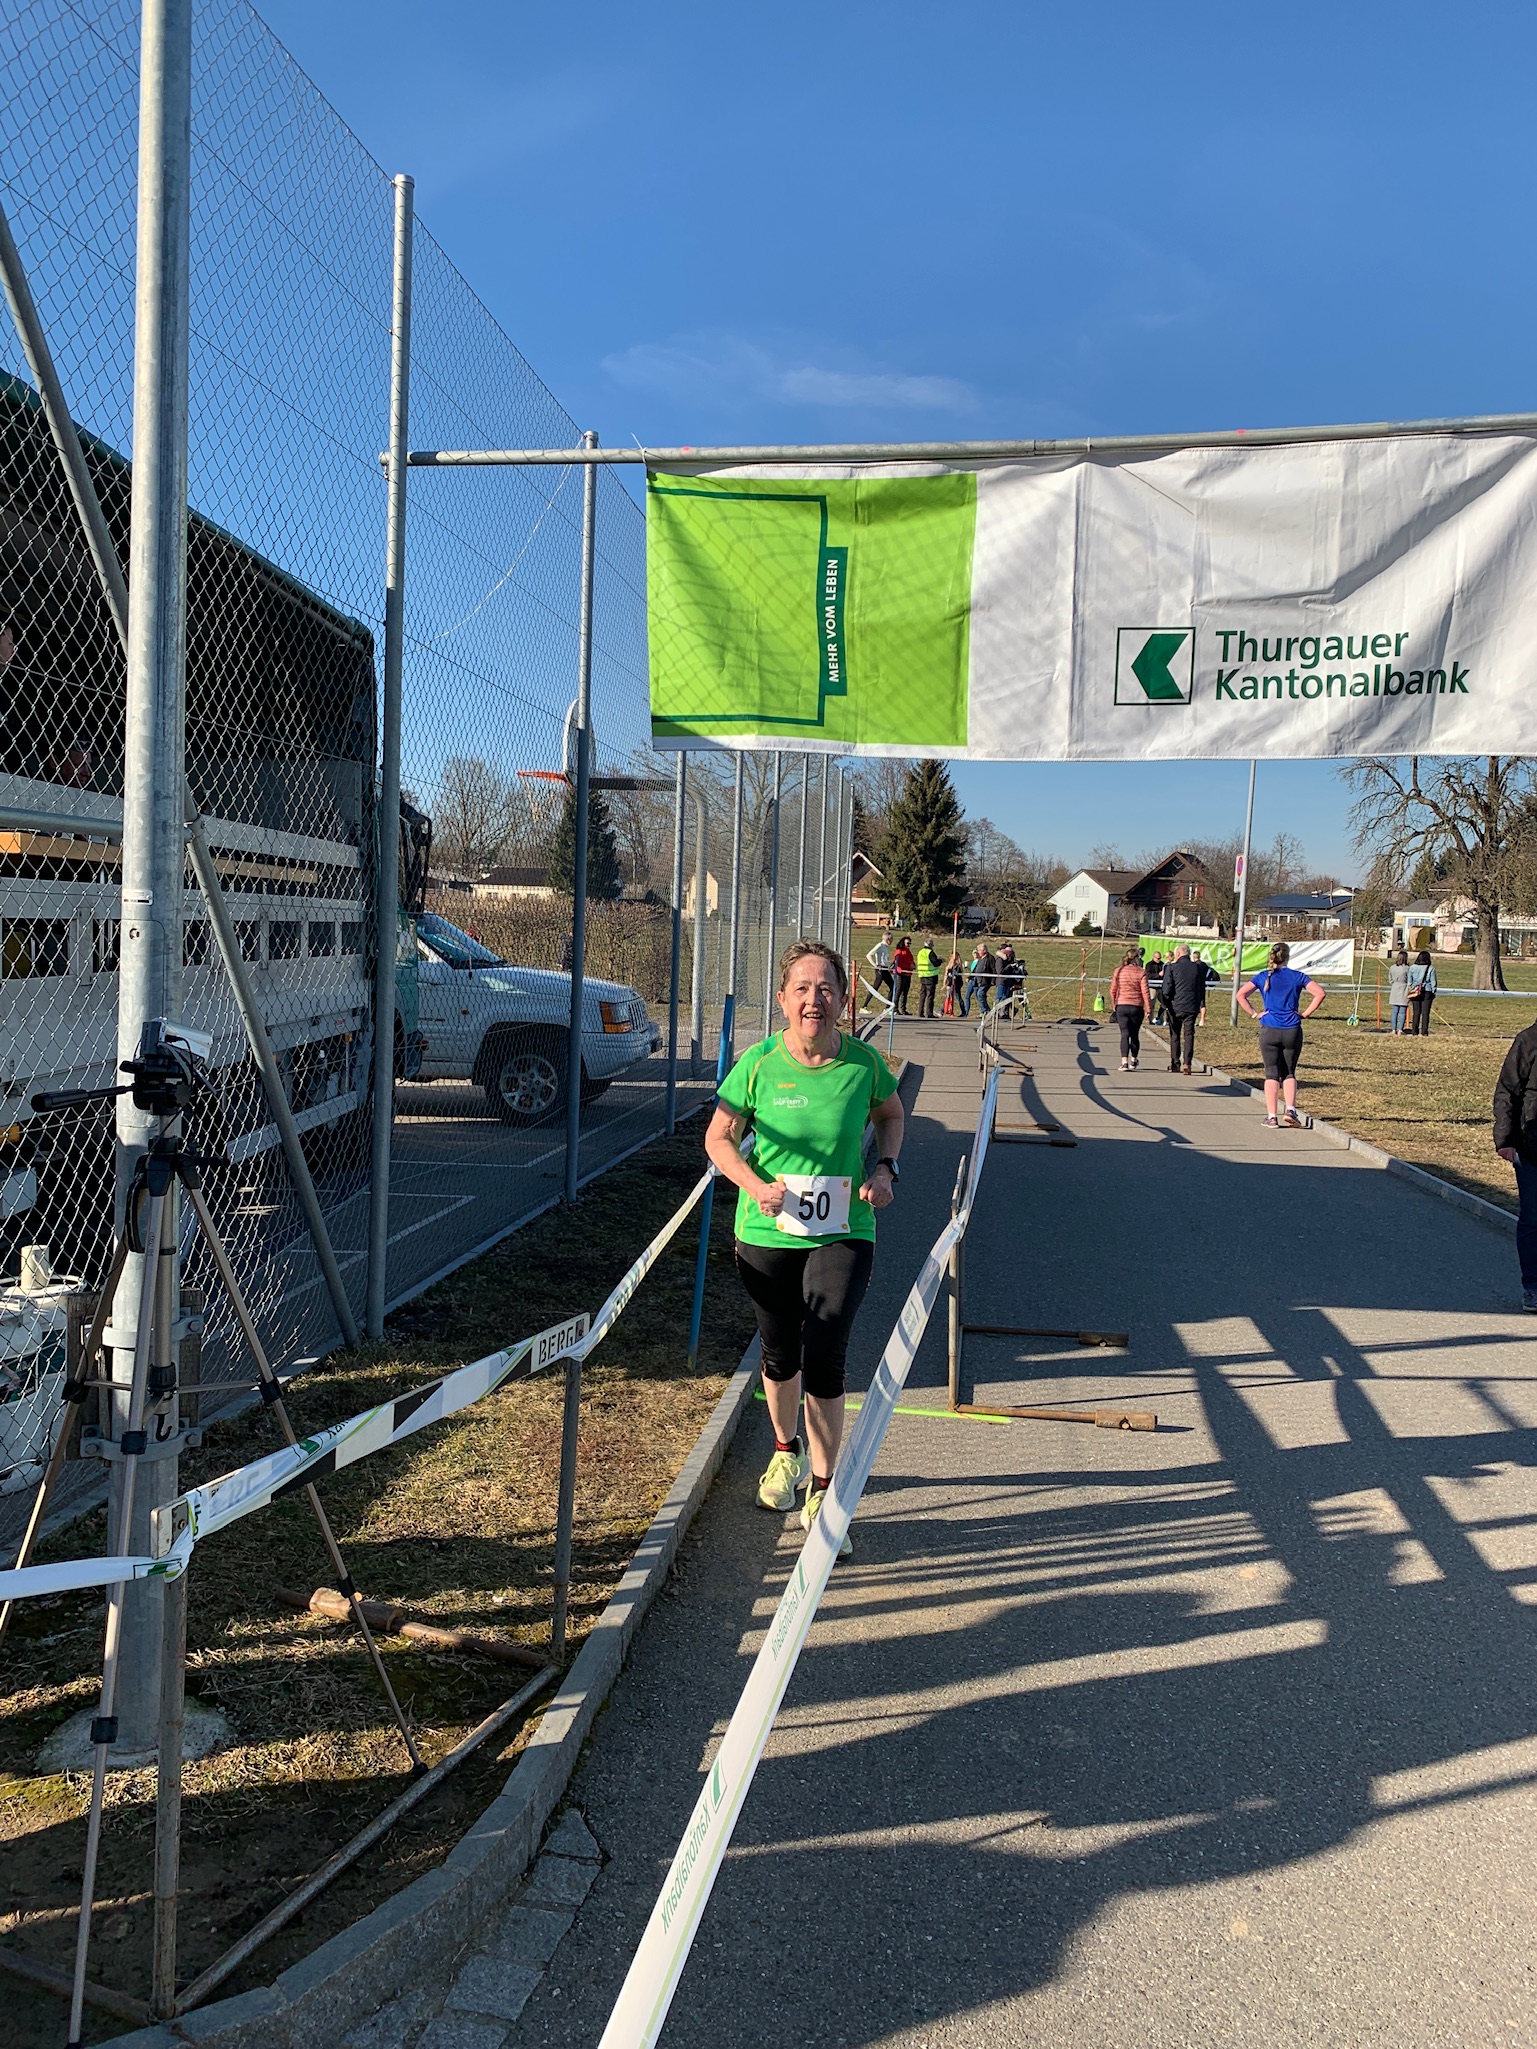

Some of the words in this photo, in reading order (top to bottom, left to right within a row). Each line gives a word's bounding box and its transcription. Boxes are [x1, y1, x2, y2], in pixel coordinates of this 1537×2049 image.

[825, 559, 838, 601] LEBEN
[825, 605, 836, 639] VOM
[827, 643, 839, 683] MEHR
[1215, 630, 1409, 669] Thurgauer
[1215, 661, 1471, 700] Kantonalbank
[798, 1190, 830, 1221] 50
[538, 1326, 574, 1365] BERG
